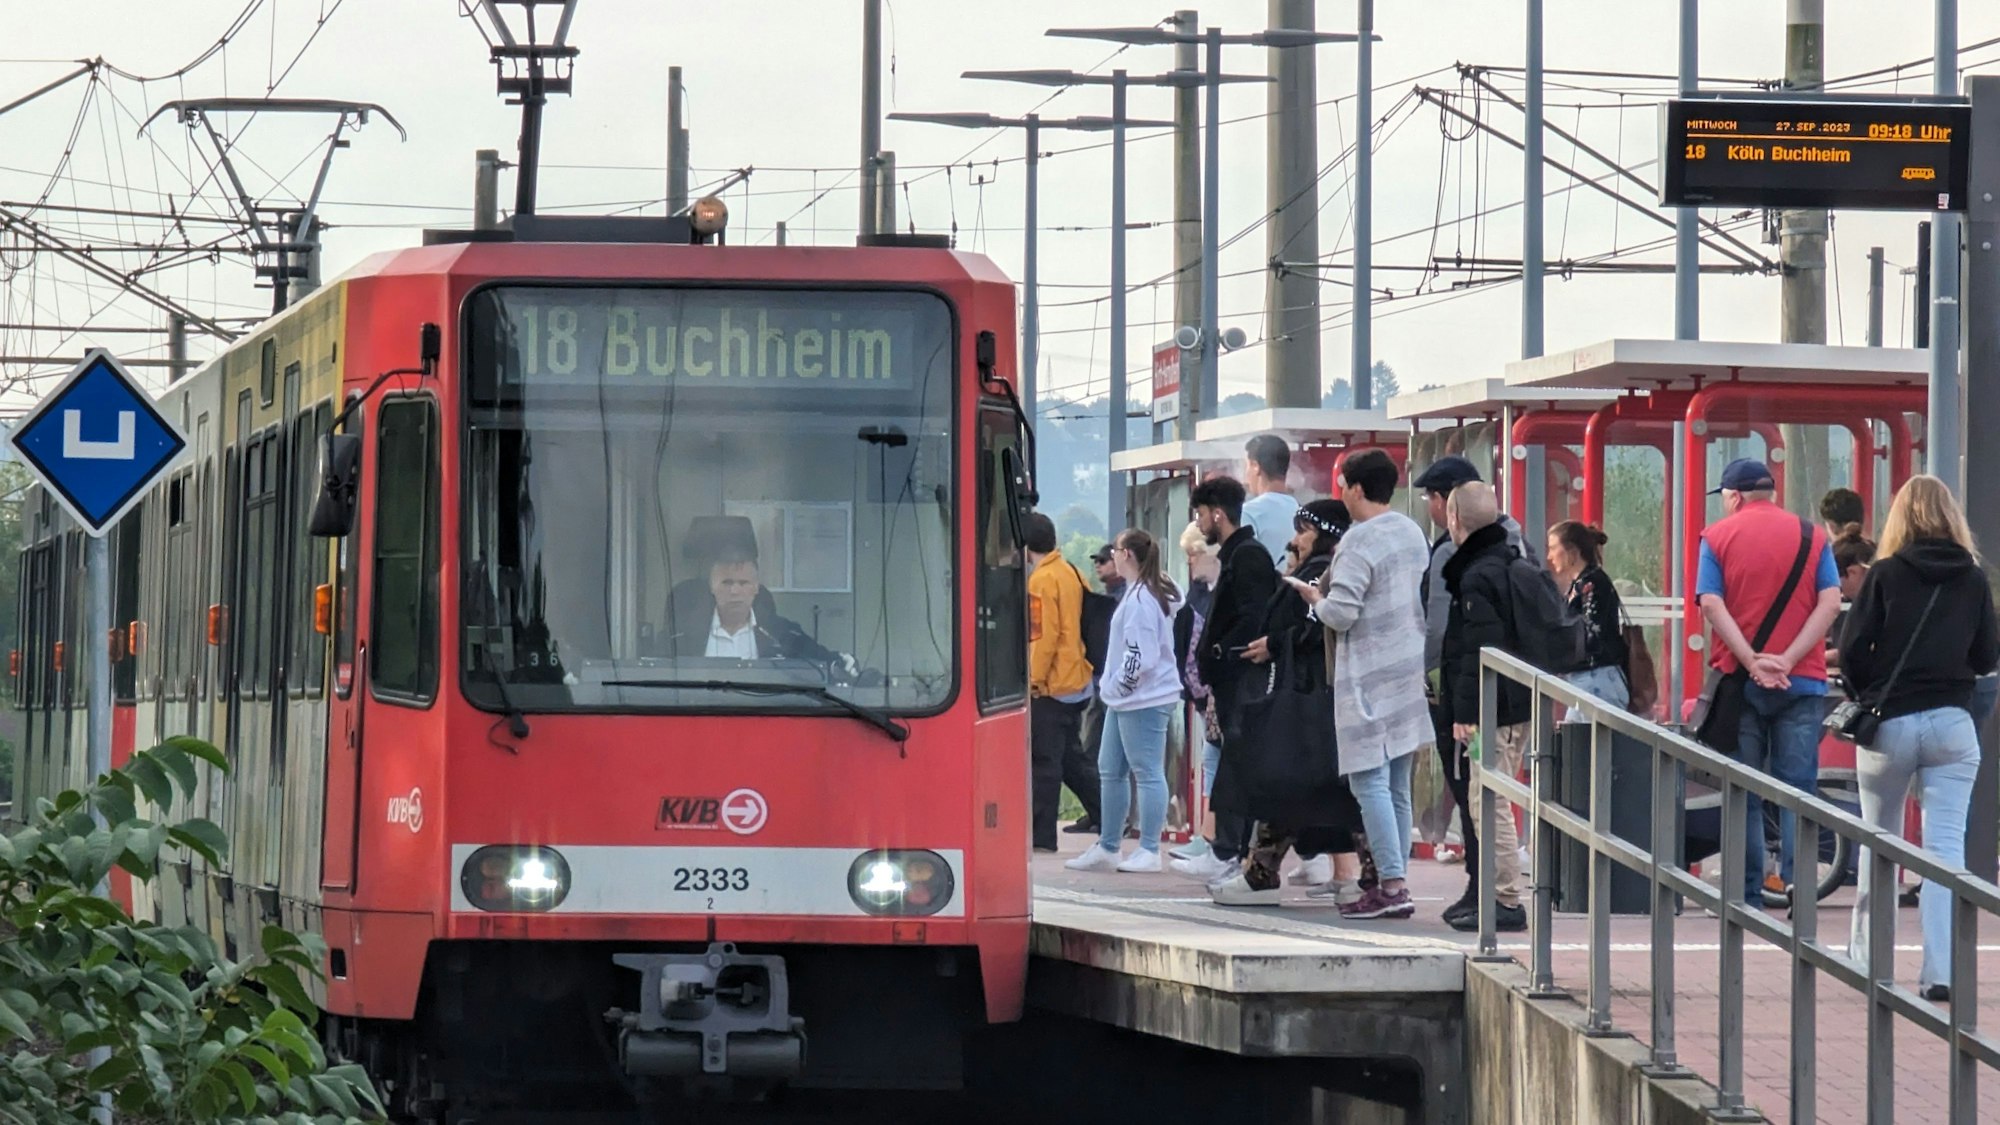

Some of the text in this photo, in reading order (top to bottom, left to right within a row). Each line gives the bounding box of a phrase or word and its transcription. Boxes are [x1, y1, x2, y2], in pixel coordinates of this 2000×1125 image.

[1686, 120, 1738, 131] MITTWOCH
[1868, 123, 1912, 139] 09:18
[1920, 125, 1952, 140] Uhr
[1685, 145, 1851, 163] 18 Köln Buchheim
[522, 306, 892, 379] 18 Buchheim
[387, 797, 409, 823] KVB
[660, 797, 721, 824] KVB
[673, 867, 750, 892] 2333
[707, 897, 715, 910] 2
